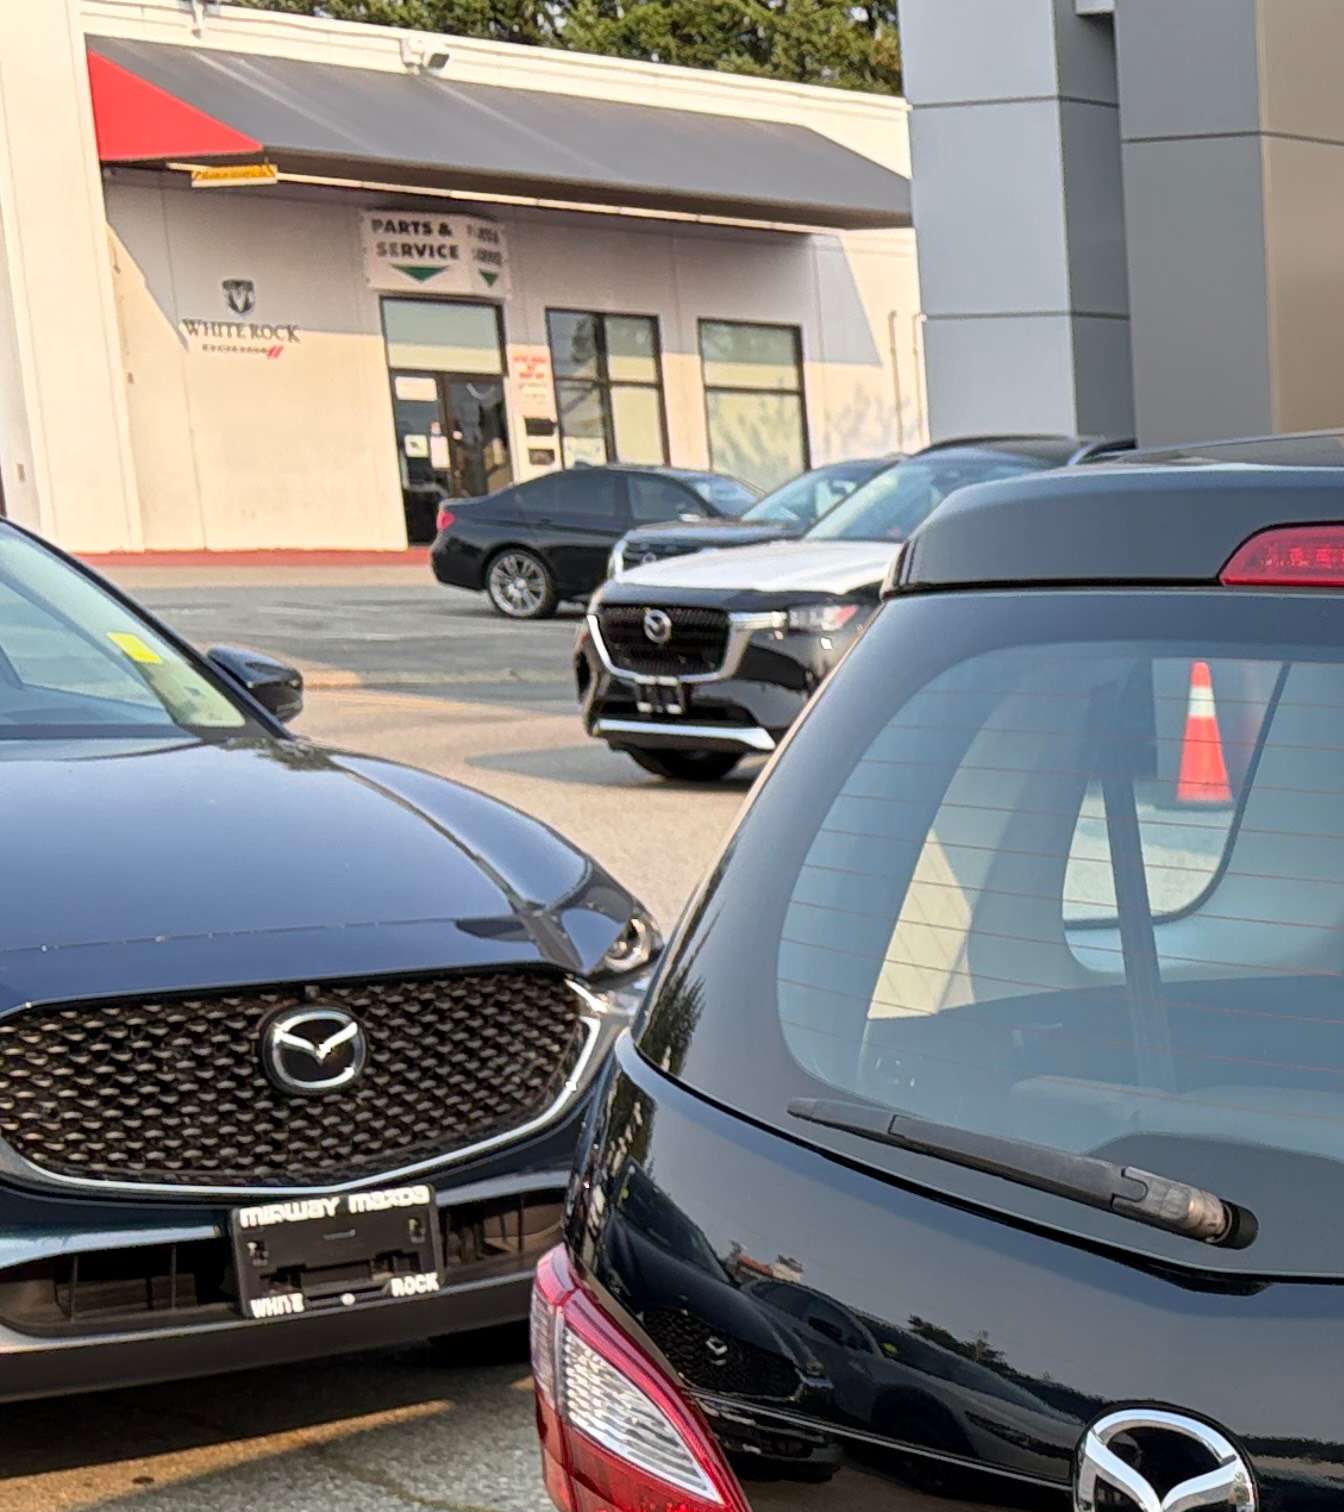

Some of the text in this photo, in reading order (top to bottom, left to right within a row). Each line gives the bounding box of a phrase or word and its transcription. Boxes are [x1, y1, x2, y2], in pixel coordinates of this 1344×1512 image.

[371, 218, 432, 236] PARTS
[438, 220, 453, 237] &
[375, 241, 460, 259] SERVICE
[248, 323, 301, 343] ROCK
[389, 1271, 440, 1298] ROCK
